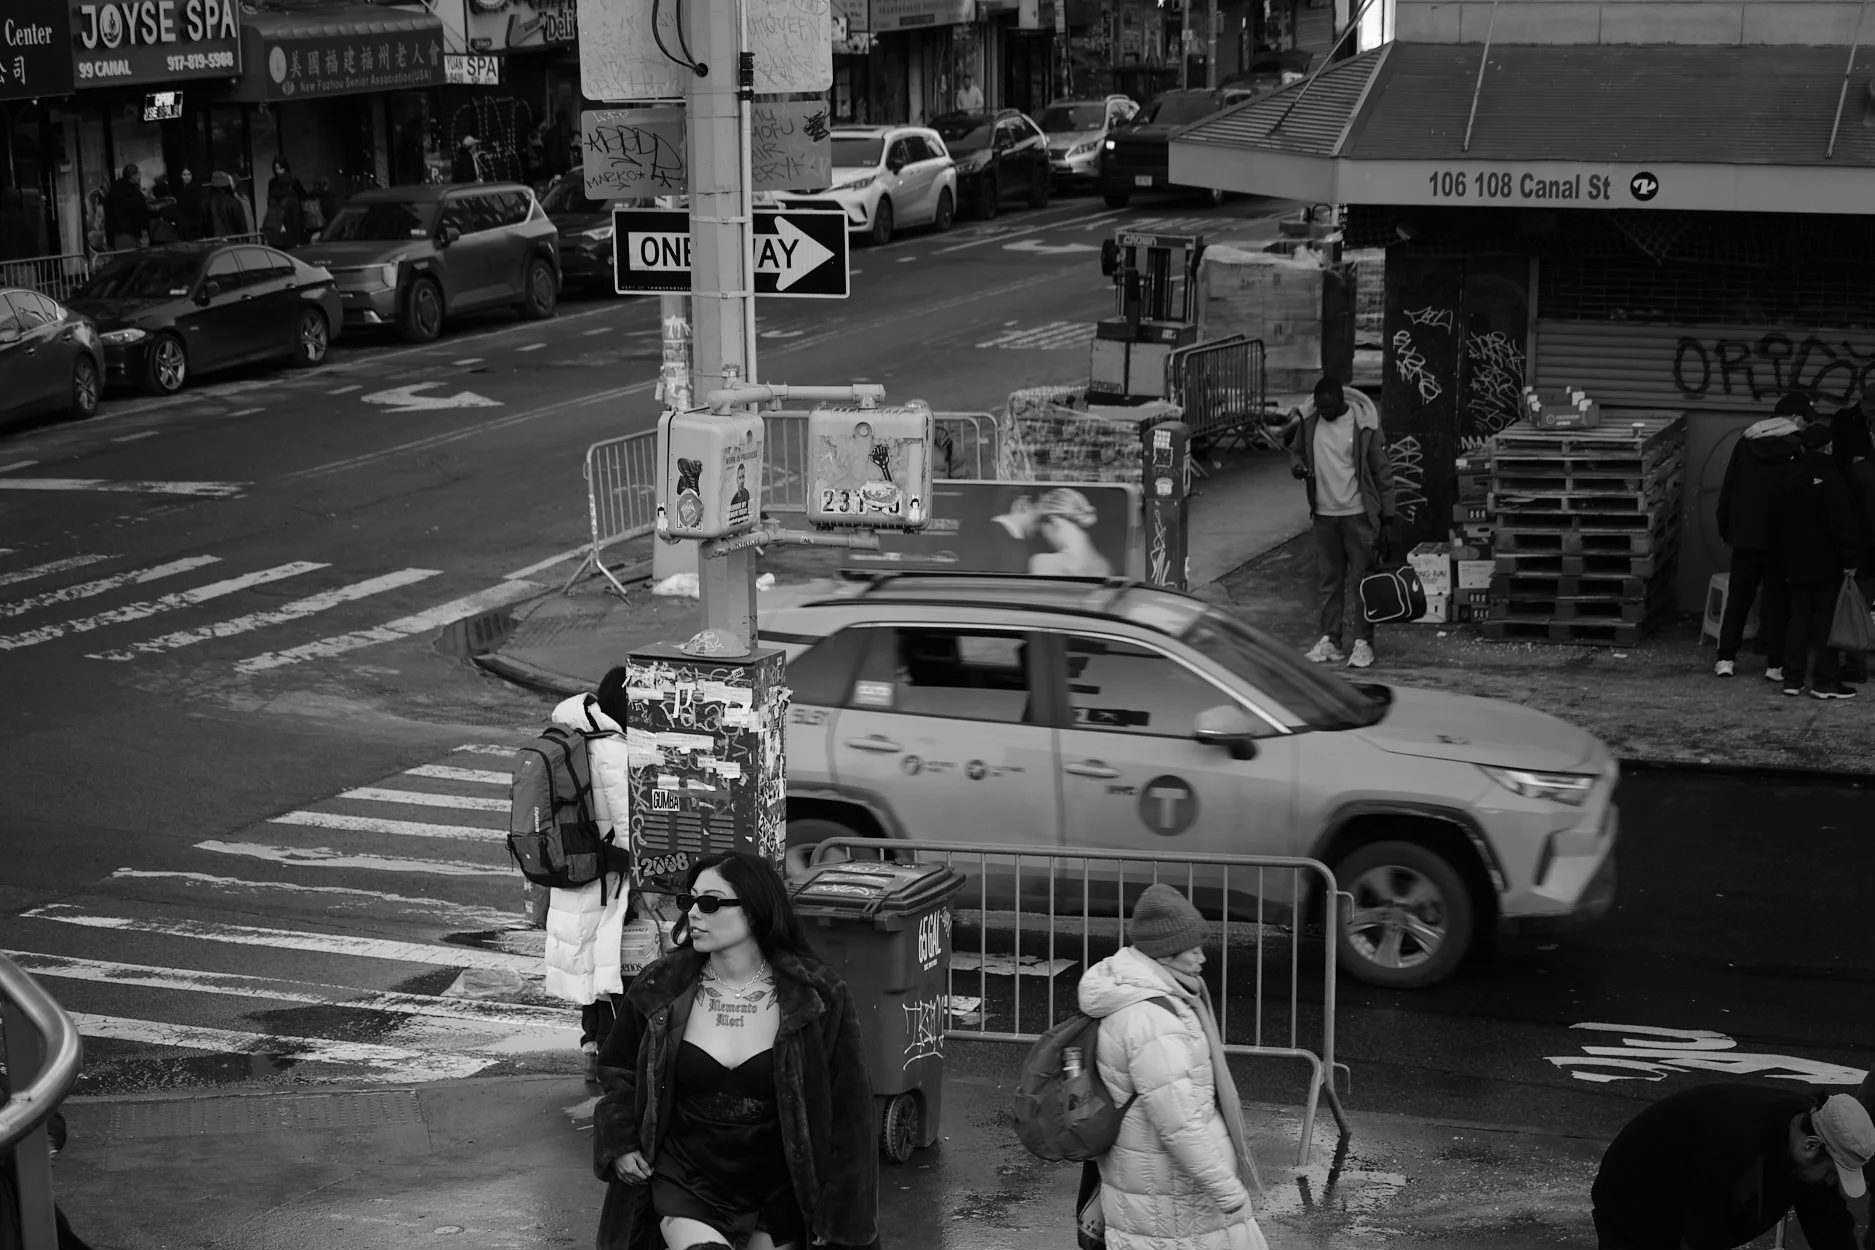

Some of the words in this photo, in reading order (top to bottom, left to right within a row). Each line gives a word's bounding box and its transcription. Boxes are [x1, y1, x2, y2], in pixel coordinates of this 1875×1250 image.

[4, 19, 52, 46] Center
[81, 1, 176, 49] JOYSE
[186, 0, 237, 41] SPA
[547, 11, 575, 40] Deli
[78, 62, 93, 79] 99
[95, 59, 132, 77] CANAL
[290, 39, 440, 78] 美國福建福州老人會
[467, 56, 497, 77] SPA
[300, 80, 316, 92] New
[318, 78, 344, 90] Fuzhou
[346, 74, 369, 88] Senior
[1428, 171, 1467, 198] 106
[1475, 172, 1512, 198] 108
[1520, 171, 1580, 200] Canal
[1587, 173, 1611, 201] St
[752, 238, 799, 269] AY
[653, 789, 680, 810] GUMBA
[641, 852, 690, 877] 2008
[918, 916, 928, 963] 65
[928, 910, 942, 959] GAL
[621, 963, 643, 973] enos
[708, 998, 758, 1014] Memento
[716, 1013, 744, 1027] Mori
